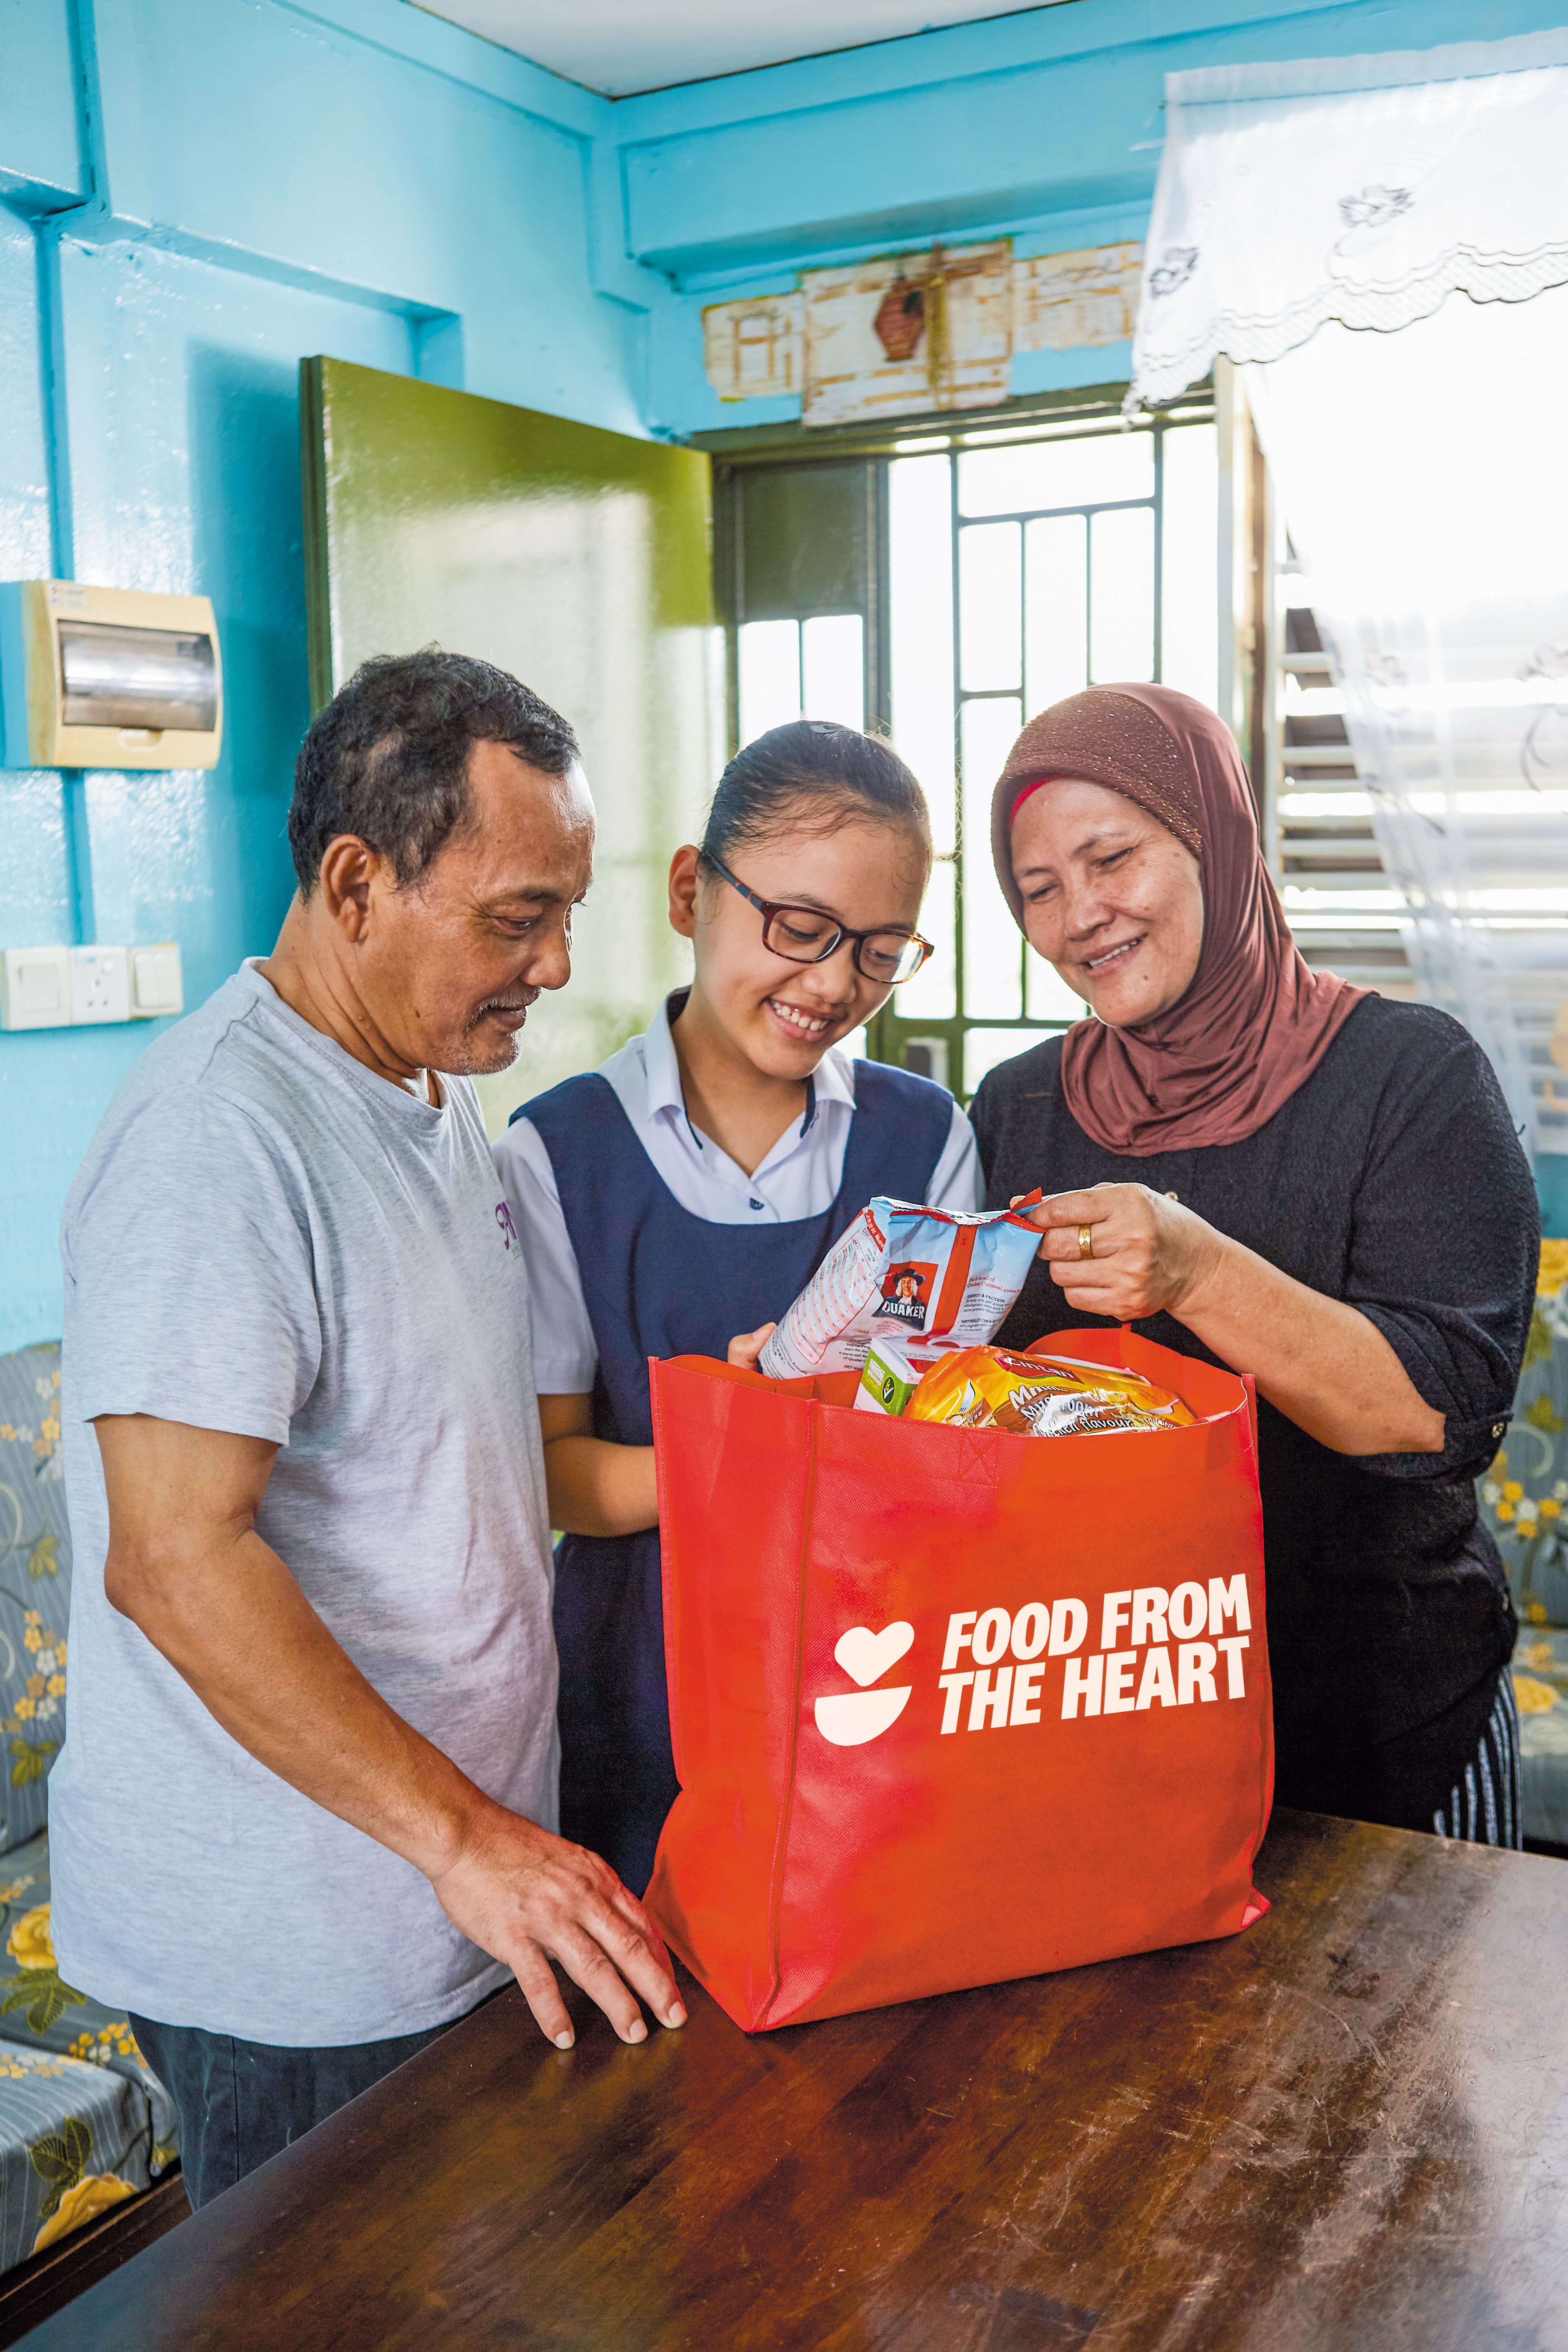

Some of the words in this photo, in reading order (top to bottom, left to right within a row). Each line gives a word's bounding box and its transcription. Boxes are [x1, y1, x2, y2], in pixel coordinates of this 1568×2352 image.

[982, 1281, 1002, 1291] Oatmeal
[881, 1301, 925, 1319] QUAKER
[1079, 1412, 1131, 1432] flavour
[941, 1598, 1088, 1670] FOOD
[1100, 1573, 1252, 1649] FROM
[938, 1662, 1046, 1735] THE
[1061, 1635, 1250, 1719] HEART
